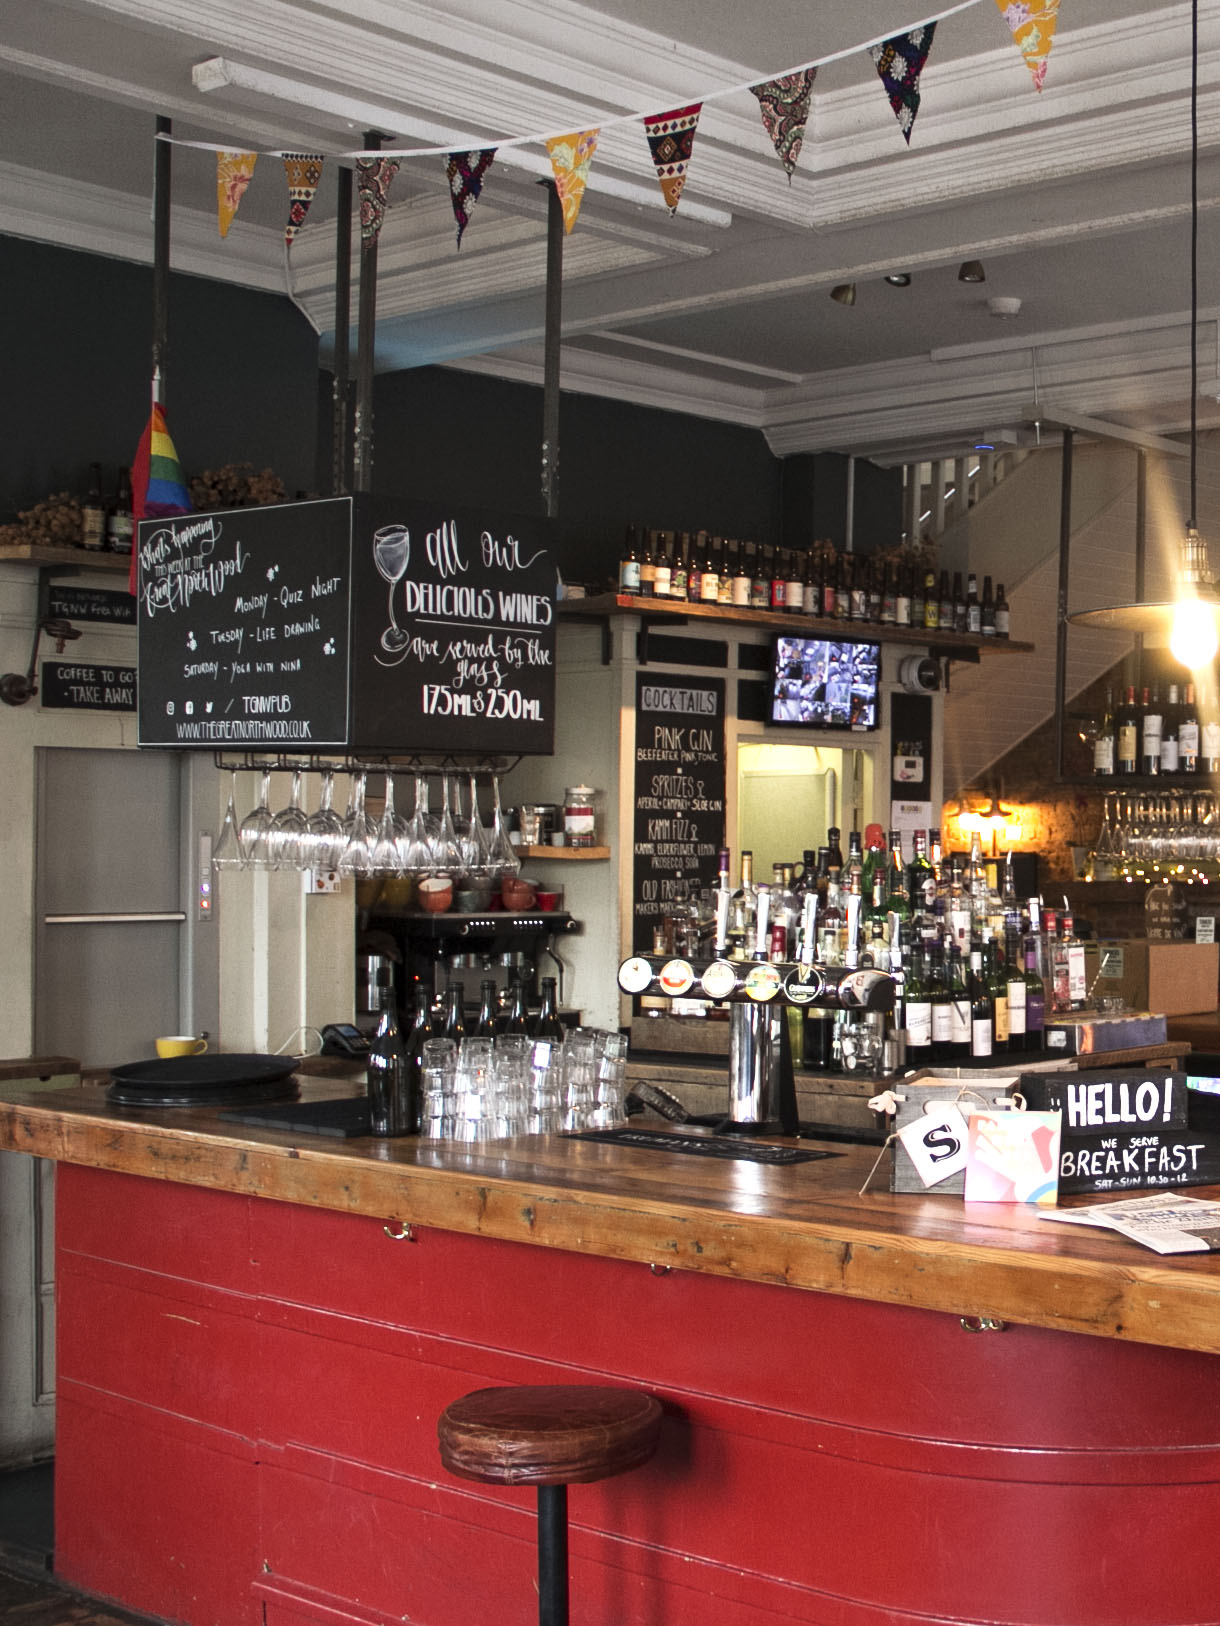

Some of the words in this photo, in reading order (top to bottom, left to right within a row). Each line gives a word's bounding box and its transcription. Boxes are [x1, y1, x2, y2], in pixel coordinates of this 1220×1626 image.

[499, 591, 552, 625] WINES
[256, 627, 277, 642] LIFE
[57, 667, 96, 682] COFFEE
[101, 670, 115, 682] TO
[69, 686, 101, 703] TAKE
[104, 687, 134, 705] AWAY
[643, 687, 715, 714] COCKTAILS
[654, 725, 685, 750] PINK
[689, 728, 713, 752] GIN
[637, 748, 679, 761] BEEFEATER
[651, 774, 694, 798] SPRITZES
[672, 819, 689, 841] FIZZ
[1067, 1077, 1173, 1127] HELLO!
[922, 1123, 961, 1163] S
[1101, 1138, 1118, 1149] WE
[1129, 1136, 1160, 1149] SERVE
[1060, 1144, 1206, 1177] BREAKFAST
